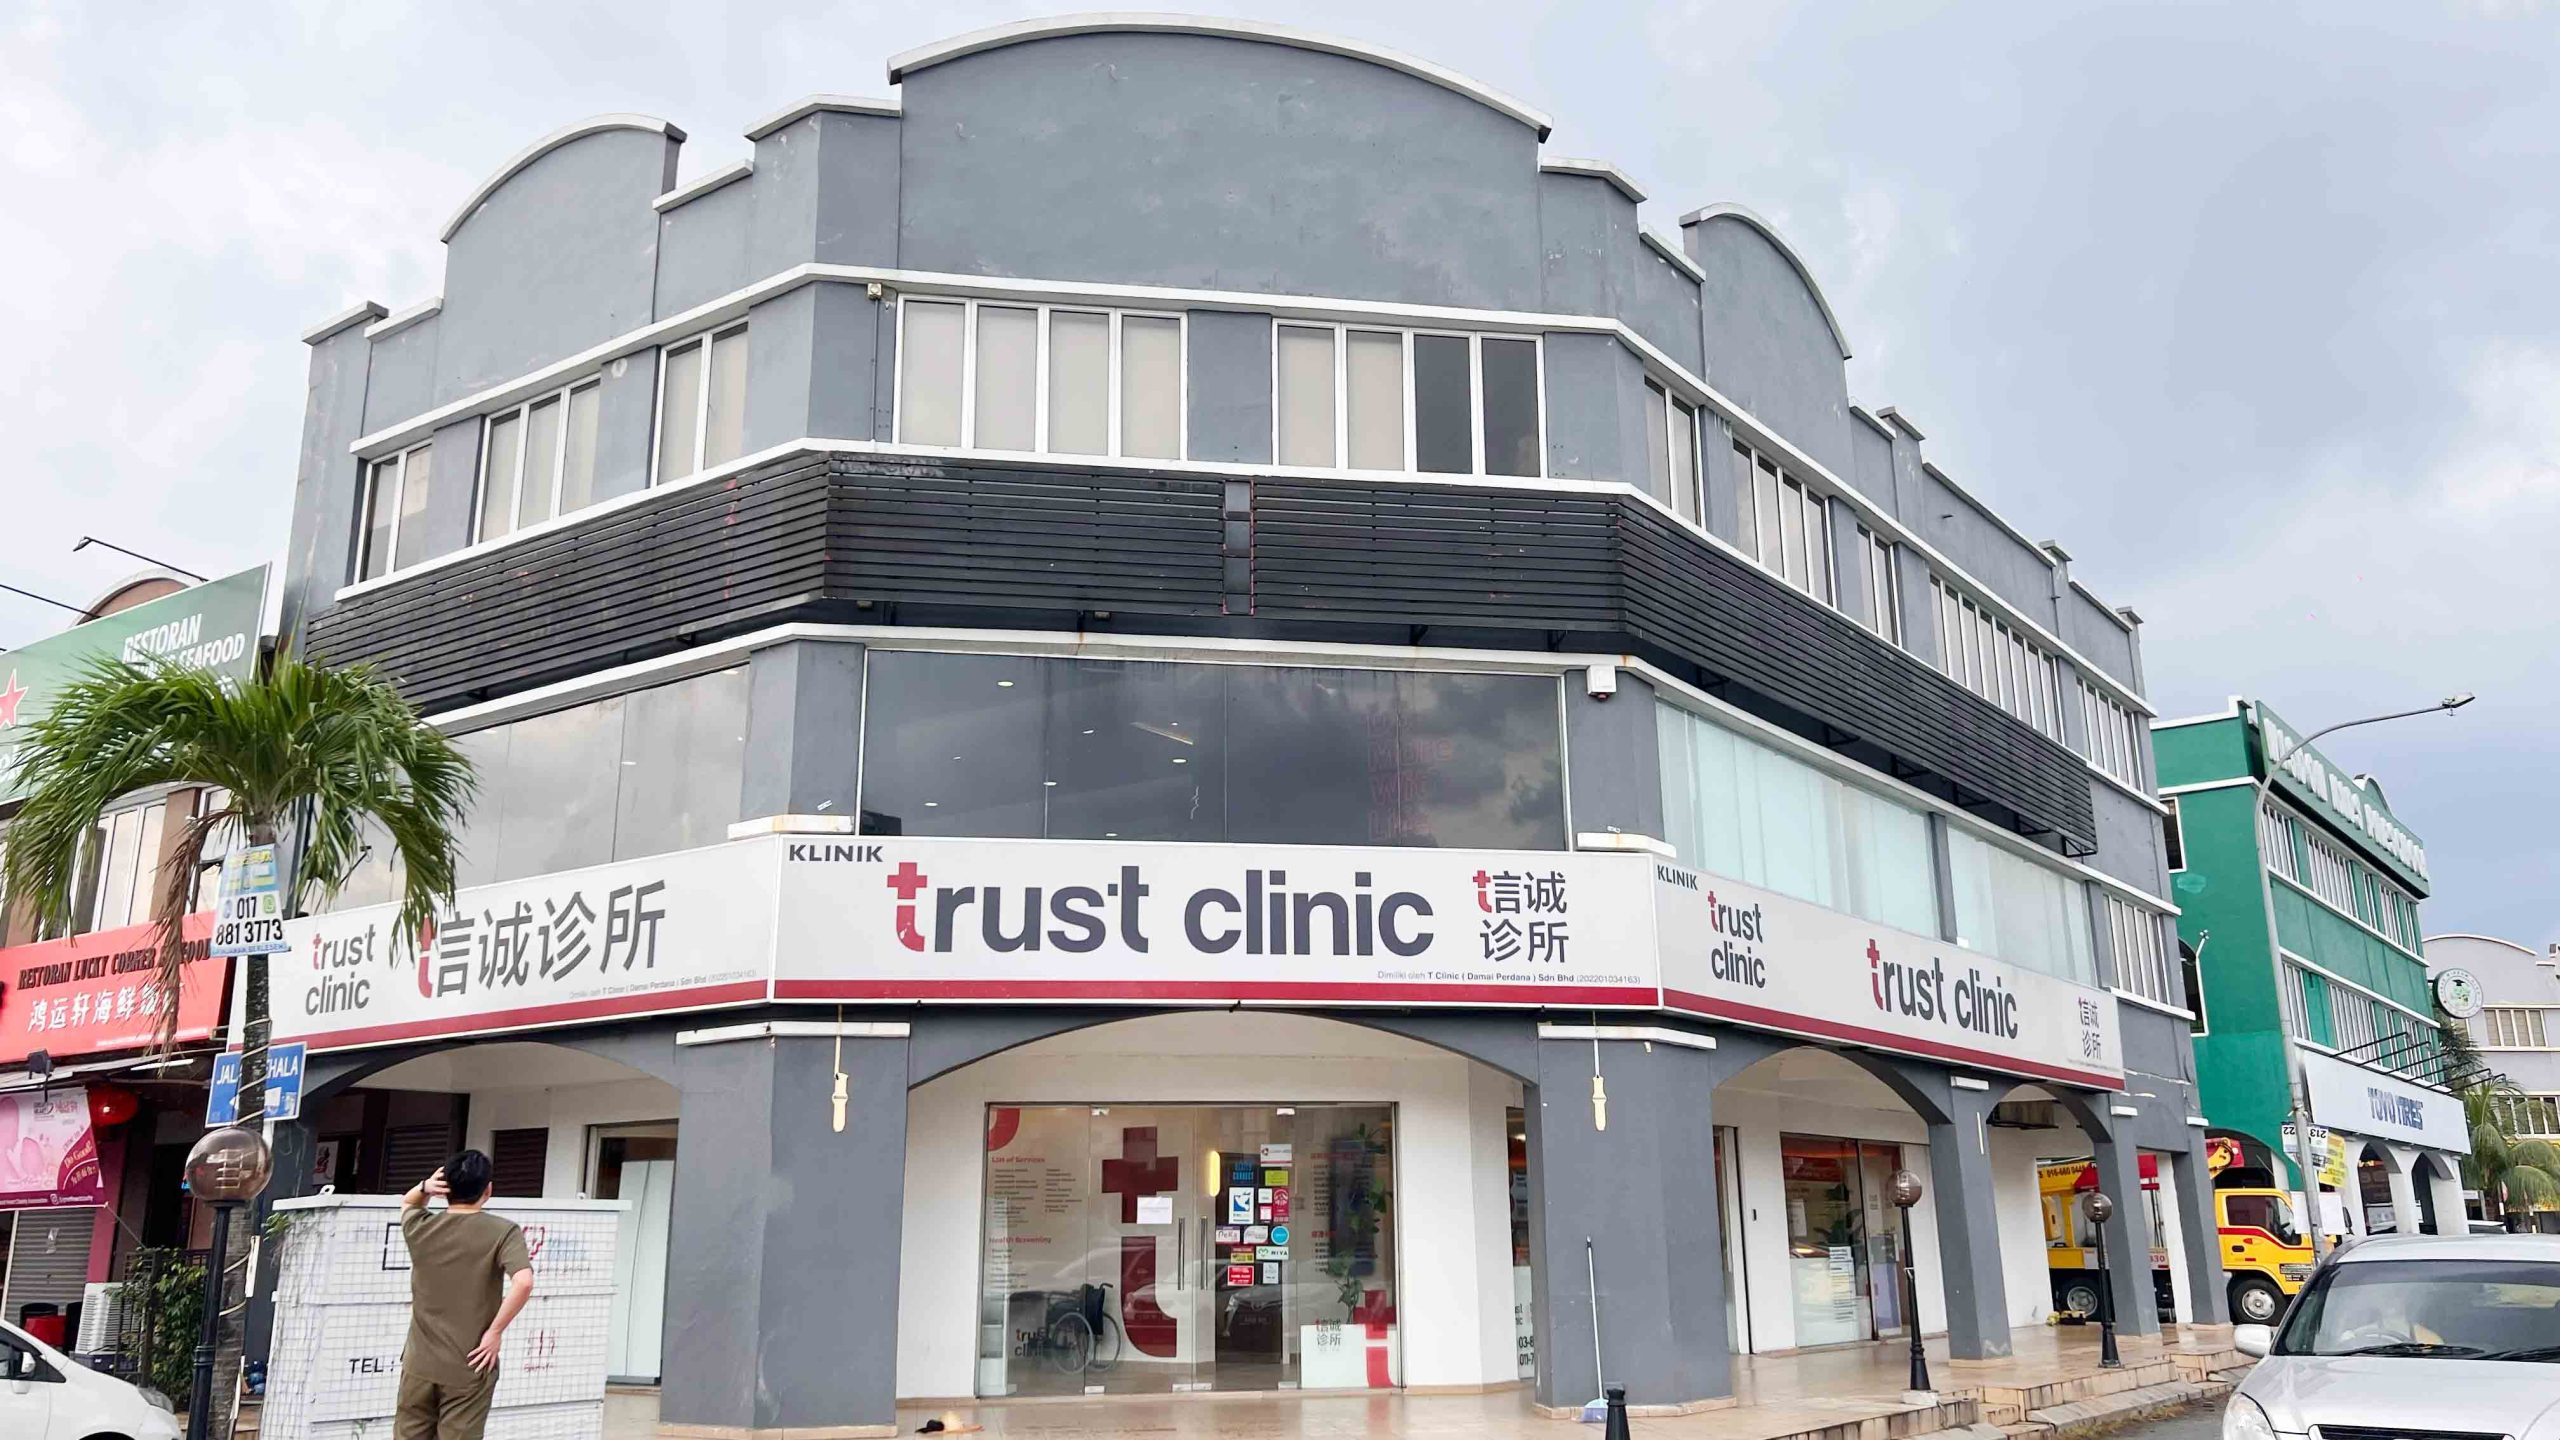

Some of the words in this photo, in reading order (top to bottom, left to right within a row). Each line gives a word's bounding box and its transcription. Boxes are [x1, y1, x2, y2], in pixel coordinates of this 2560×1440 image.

[121, 613, 203, 664] RESTORAN
[789, 844, 884, 863] KLINIK
[1656, 864, 1699, 891] KLINIK
[237, 896, 258, 920] 017
[887, 861, 1150, 954] trust
[1184, 869, 1434, 957] clinic
[1707, 890, 1763, 943] trust
[216, 922, 241, 946] 881
[244, 918, 284, 943] 3773
[313, 923, 377, 970] trust
[1479, 918, 1570, 963] 诊所
[17, 961, 73, 990] RESTORAN
[72, 955, 109, 982] LUCKY
[111, 947, 157, 975] CORNER
[1428, 971, 1434, 980] T
[1435, 971, 1460, 980] Clinic
[1467, 972, 1495, 981] Damai
[1495, 973, 1531, 982] Perdana
[1538, 973, 1555, 982] Sdn
[1557, 973, 1575, 982] Bhd
[1711, 940, 1766, 989] clinic
[305, 971, 370, 1016] clinic
[1866, 938, 1948, 1025] trust
[1954, 967, 2019, 1040] clinic
[349, 1358, 384, 1374] TEL
